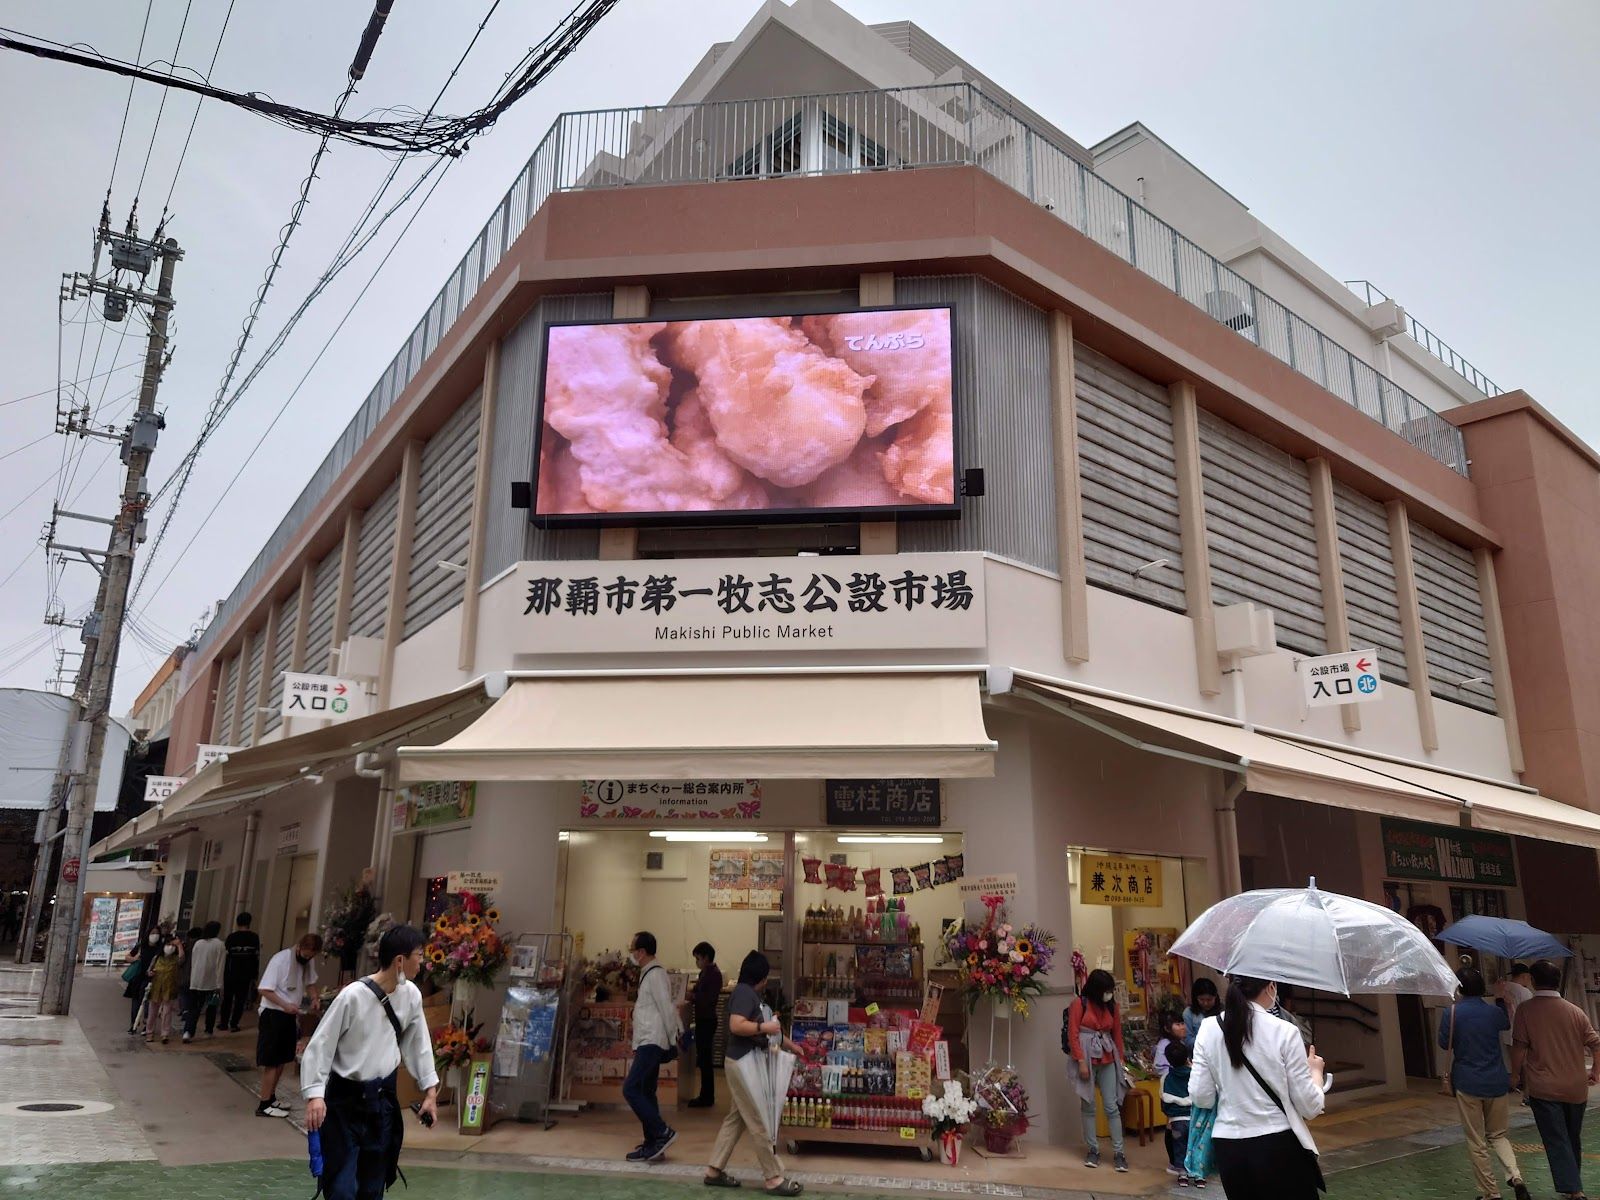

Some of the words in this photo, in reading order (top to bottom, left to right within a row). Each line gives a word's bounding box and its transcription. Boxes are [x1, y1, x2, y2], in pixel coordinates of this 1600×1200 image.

[845, 333, 926, 352] てんぷら
[523, 570, 974, 616] 那覇市第一牧志公設市場
[655, 626, 716, 639] Makishi
[722, 625, 770, 639] Public
[777, 624, 834, 638] Market
[1310, 663, 1350, 677] 公設市場
[292, 682, 328, 692] 公設市場
[1313, 678, 1353, 699] 入口
[1360, 676, 1376, 692] 北
[289, 694, 326, 710] 入口
[149, 788, 171, 797] 入口
[658, 798, 708, 806] information
[1091, 872, 1153, 894] 兼次商店
